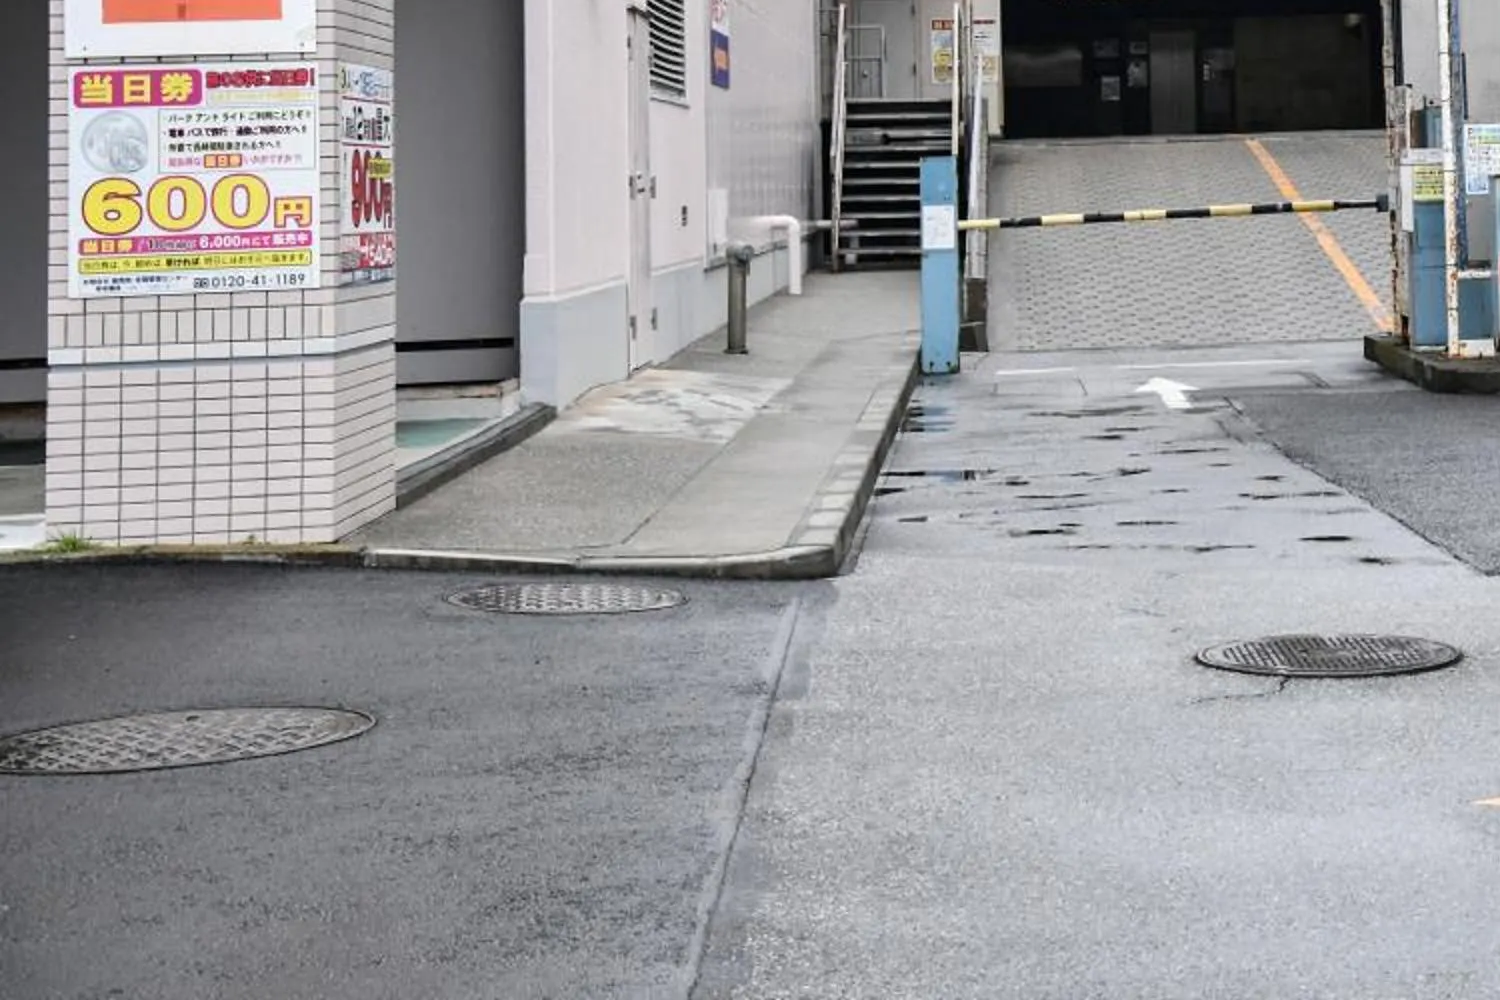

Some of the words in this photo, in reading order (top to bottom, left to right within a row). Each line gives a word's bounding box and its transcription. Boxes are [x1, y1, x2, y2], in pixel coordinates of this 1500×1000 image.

[79, 73, 194, 104] 当日券
[81, 173, 313, 236] 600円
[212, 274, 306, 288] 0120-41-1189
